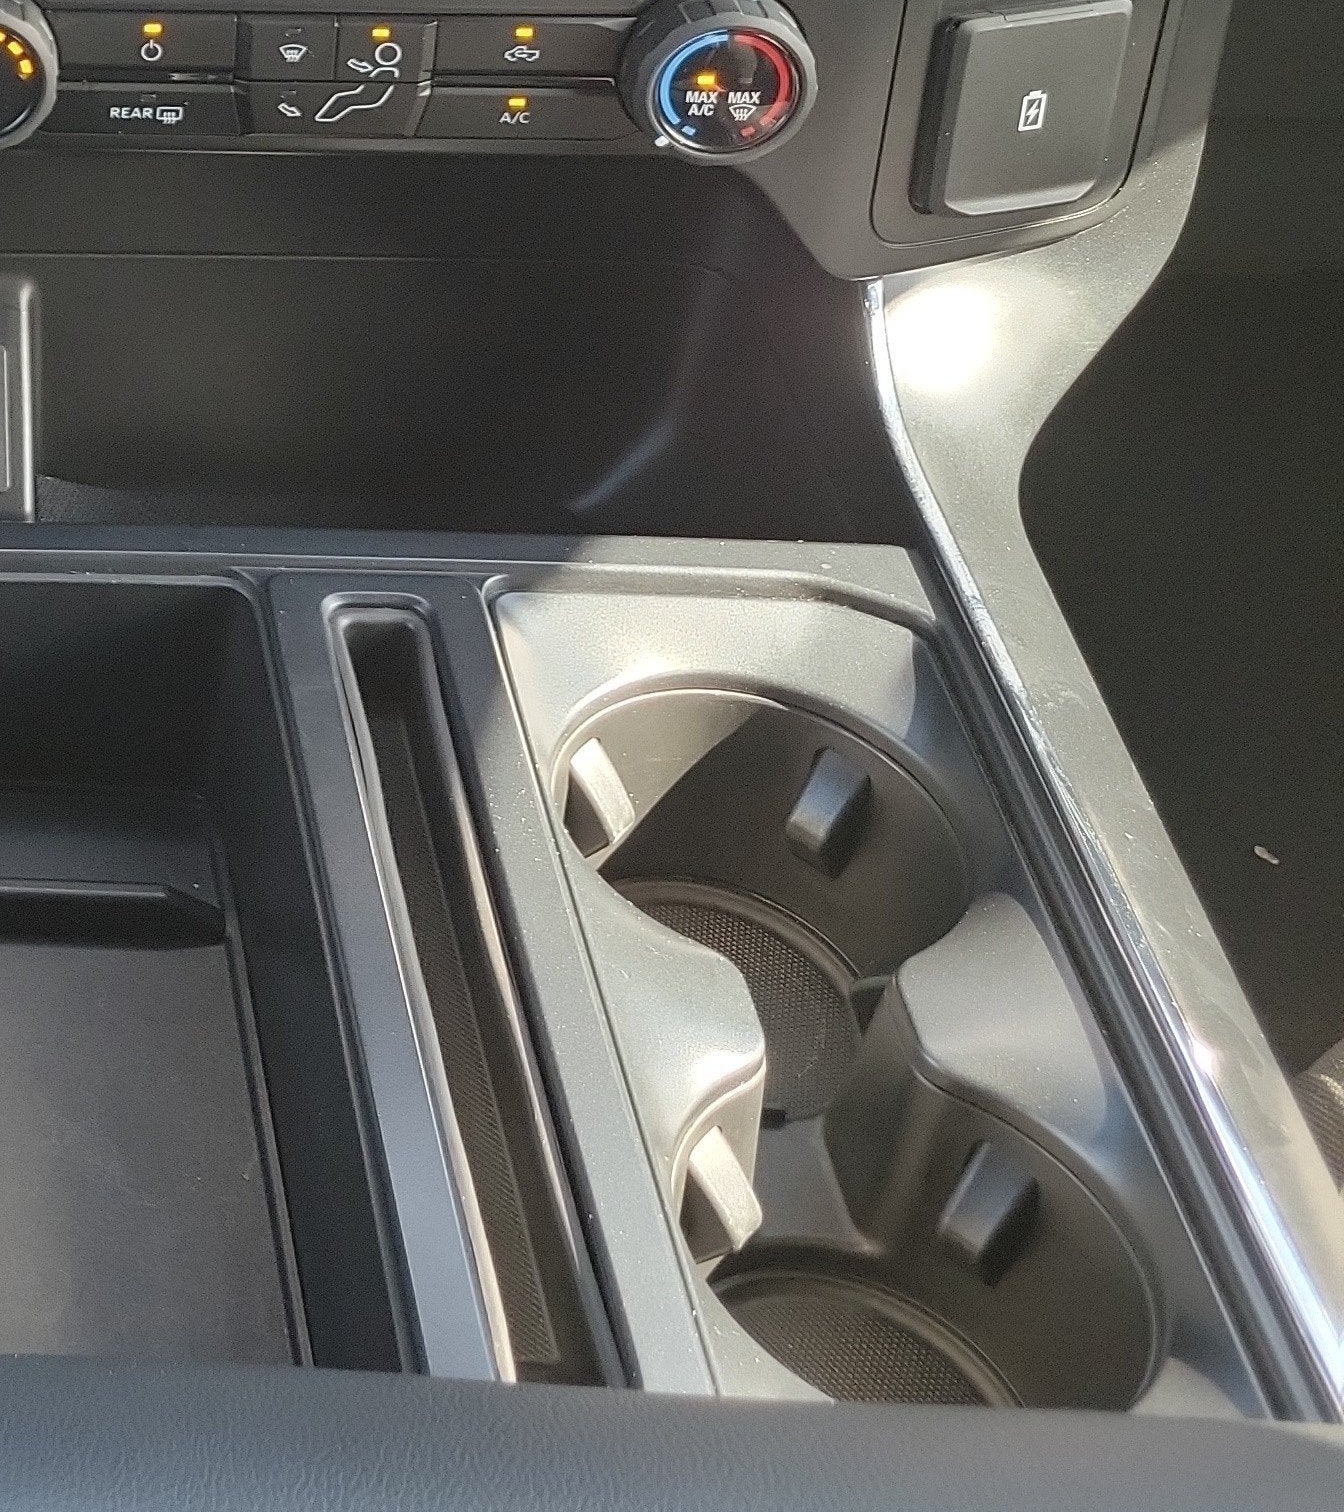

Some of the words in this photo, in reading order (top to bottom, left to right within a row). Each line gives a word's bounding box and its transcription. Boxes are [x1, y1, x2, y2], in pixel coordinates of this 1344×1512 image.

[685, 90, 719, 104] MAX
[727, 91, 762, 104] MAX
[109, 106, 154, 119] REAR
[687, 103, 715, 117] A/C
[499, 111, 530, 124] A/C
